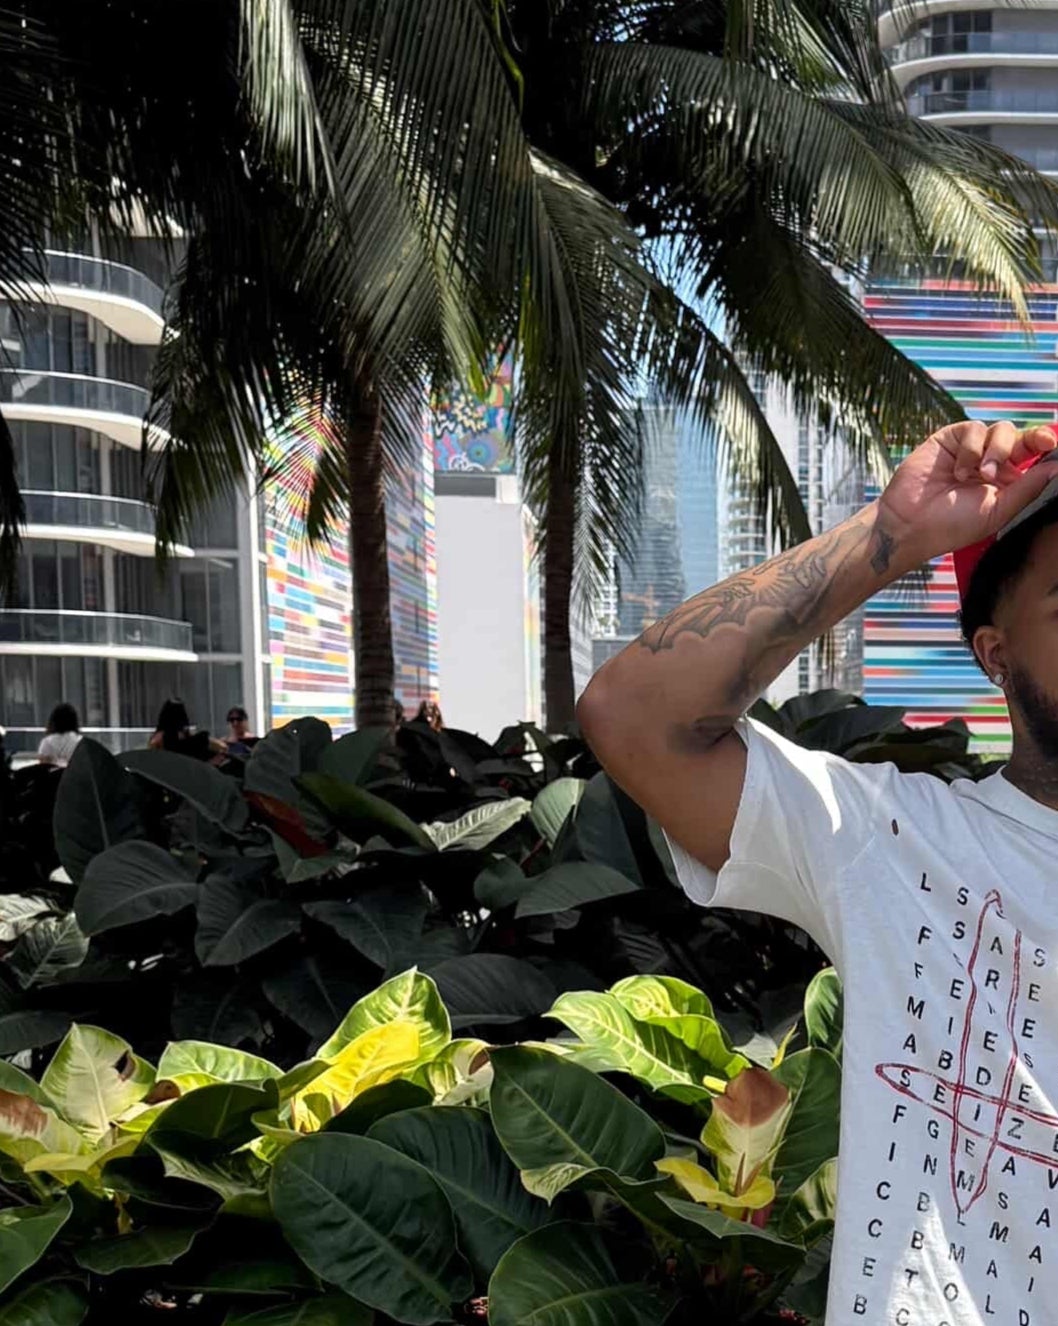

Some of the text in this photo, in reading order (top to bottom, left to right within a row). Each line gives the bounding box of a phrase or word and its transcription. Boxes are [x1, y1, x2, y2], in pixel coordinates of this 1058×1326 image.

[921, 873, 931, 892] L
[957, 887, 969, 905] S
[918, 926, 932, 944] F
[985, 969, 999, 989] R
[1028, 983, 1040, 1002] E
[953, 921, 965, 939] S
[990, 937, 1003, 955] A
[1033, 949, 1045, 967] S
[907, 996, 925, 1019] M
[983, 1031, 998, 1052] E
[950, 979, 964, 999] E
[1022, 1018, 1035, 1038] E
[903, 1034, 916, 1053] A
[938, 1050, 953, 1070] B
[976, 1067, 991, 1085] D
[1019, 1084, 1032, 1103] E
[900, 1071, 910, 1088] S
[933, 1084, 945, 1103] E
[974, 1104, 981, 1121] I
[1008, 1118, 1024, 1139] Z
[893, 1105, 906, 1123] F
[928, 1120, 939, 1139] G
[965, 1139, 975, 1157] E
[1002, 1156, 1015, 1175] A
[889, 1142, 896, 1161] I
[924, 1154, 937, 1175] N
[957, 1170, 975, 1191] M
[998, 1192, 1008, 1209] S
[1036, 1208, 1050, 1228] A
[868, 1219, 882, 1238] C
[911, 1231, 924, 1250] B
[949, 1243, 965, 1263] M
[986, 1260, 997, 1278] A
[877, 1181, 891, 1200] C
[917, 1192, 930, 1212] B
[989, 1222, 1009, 1242] M
[1029, 1246, 1041, 1263] A
[853, 1295, 867, 1315] B
[896, 1308, 910, 1326] C
[863, 1257, 876, 1277] E
[905, 1269, 919, 1286] T
[943, 1283, 958, 1302] O
[985, 1294, 995, 1314] L
[1019, 1309, 1029, 1326] D
